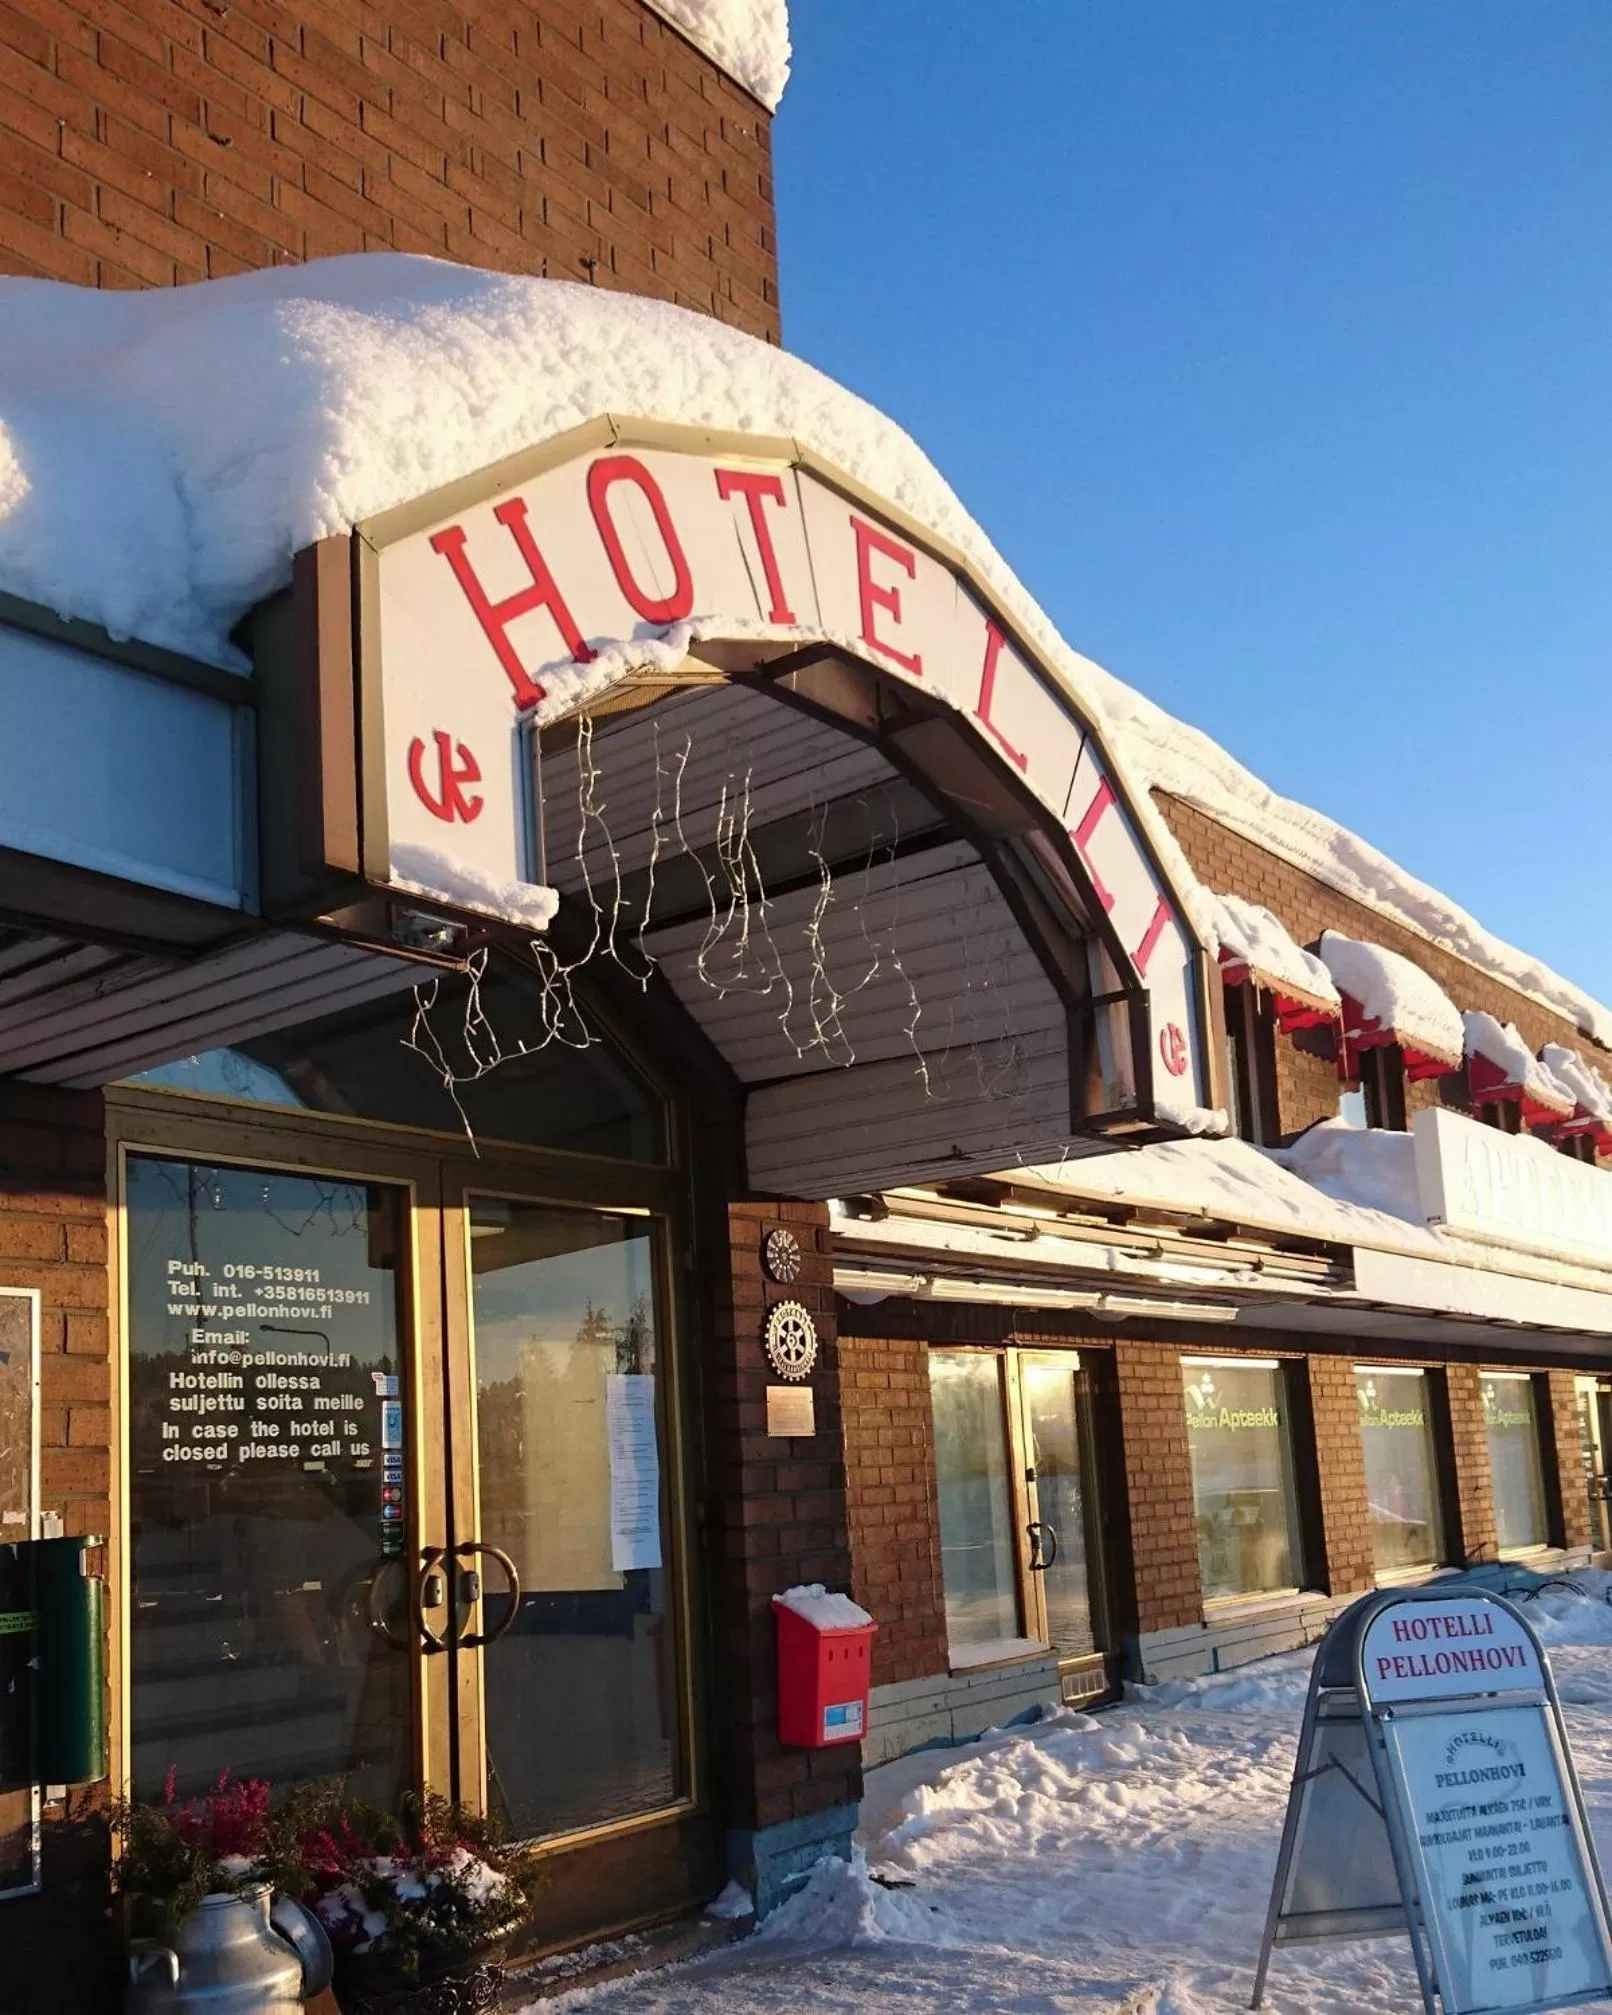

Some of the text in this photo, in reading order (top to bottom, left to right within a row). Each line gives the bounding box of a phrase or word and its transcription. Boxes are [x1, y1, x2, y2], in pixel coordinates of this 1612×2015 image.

[430, 455, 1172, 978] HOTELLI
[167, 1260, 320, 1283] Puh. 016-513911
[167, 1280, 370, 1305] Tel. int. +35816513911
[167, 1303, 333, 1320] www.pellonhovi.fi
[191, 1328, 250, 1345] Email:
[191, 1349, 351, 1368] info@pellonhovi.fi
[170, 1373, 321, 1390] Hotellin ollessa
[170, 1394, 365, 1415] suljettu soita meille
[162, 1420, 358, 1439] In case the hotel is
[163, 1440, 370, 1462] closed please call us
[1392, 1613, 1494, 1642] HOTELLI
[1376, 1645, 1527, 1680] PELLONHOVI
[1435, 1763, 1526, 1789] PELLONHOVI
